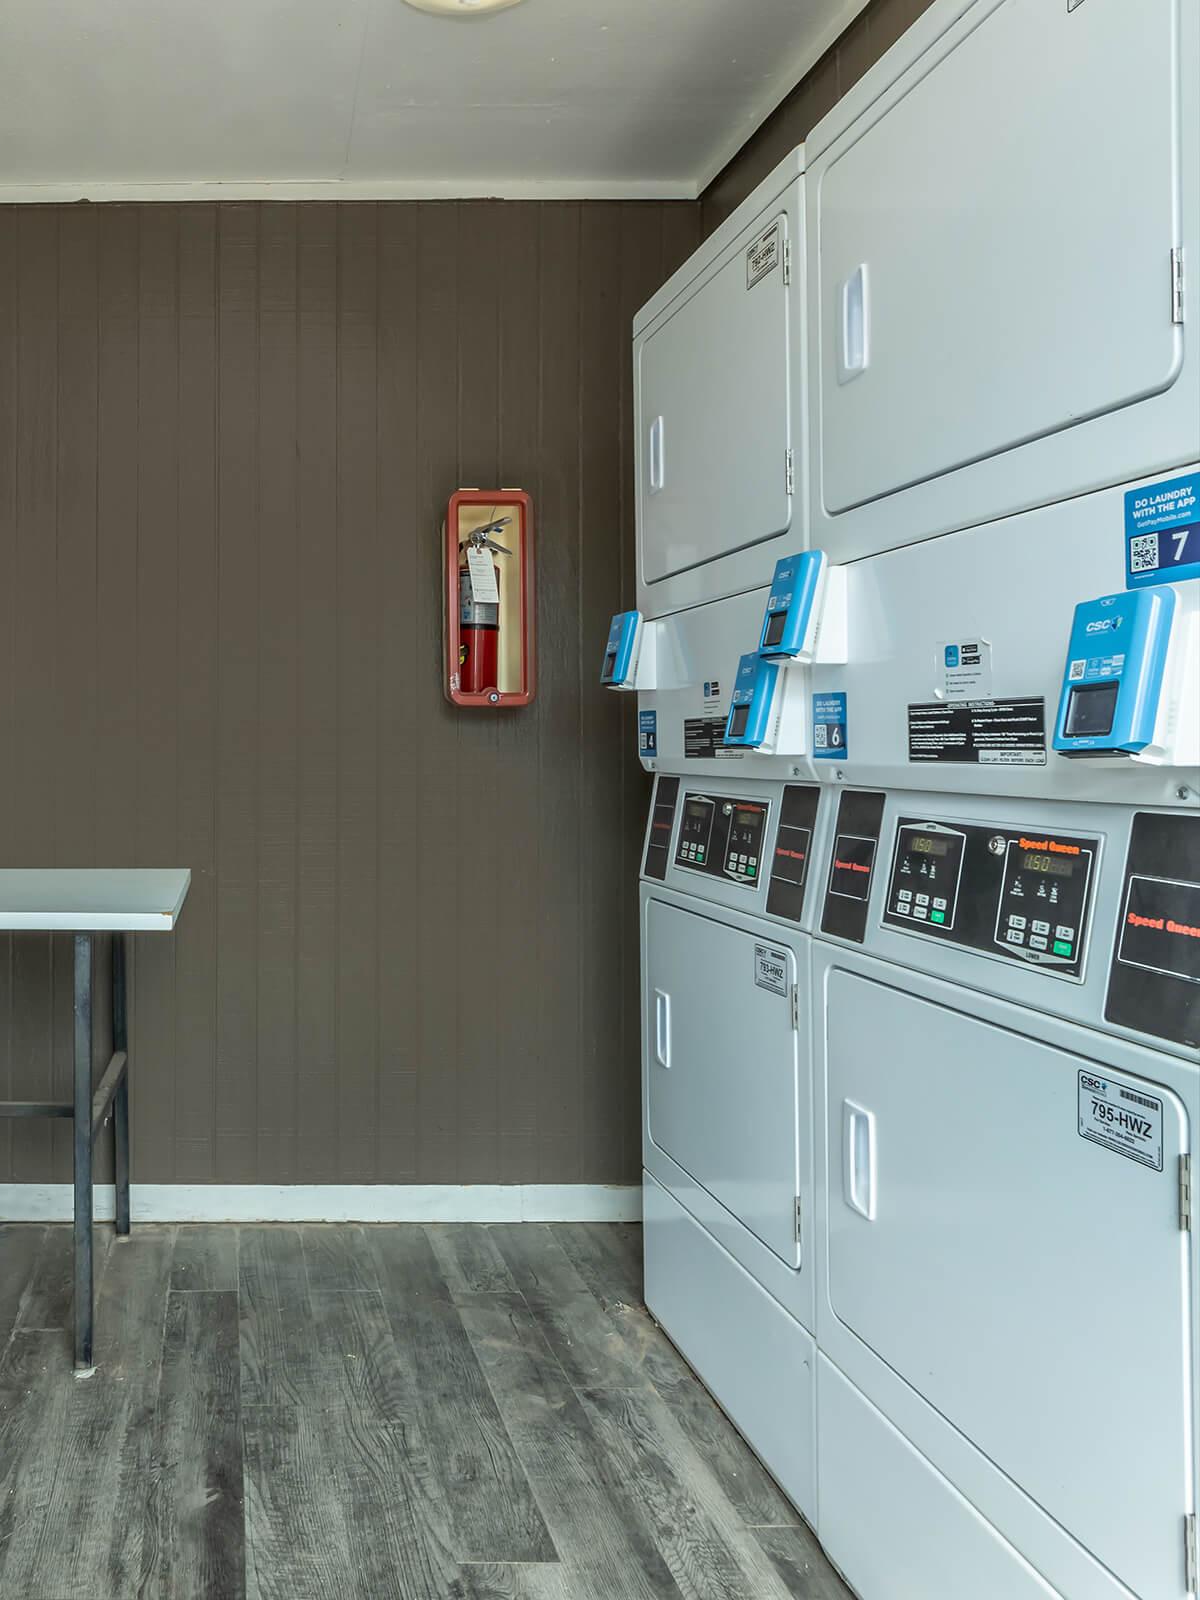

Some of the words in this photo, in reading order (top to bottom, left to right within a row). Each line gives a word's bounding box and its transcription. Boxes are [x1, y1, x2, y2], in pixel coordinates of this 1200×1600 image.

[1135, 499, 1148, 508] DO
[1149, 487, 1193, 505] LAUNDRY
[1133, 507, 1156, 519] WITH
[1158, 502, 1175, 512] THE
[1177, 496, 1196, 509] APP
[1172, 531, 1189, 561] 7
[1086, 620, 1110, 632] CSC
[649, 735, 654, 748] 4
[832, 727, 840, 745] 6
[1019, 837, 1048, 851] Speed
[1049, 841, 1080, 855] Queen
[1127, 912, 1165, 931] Speed
[1081, 1075, 1101, 1089] CSC
[1091, 1100, 1153, 1139] 795-HWZ
